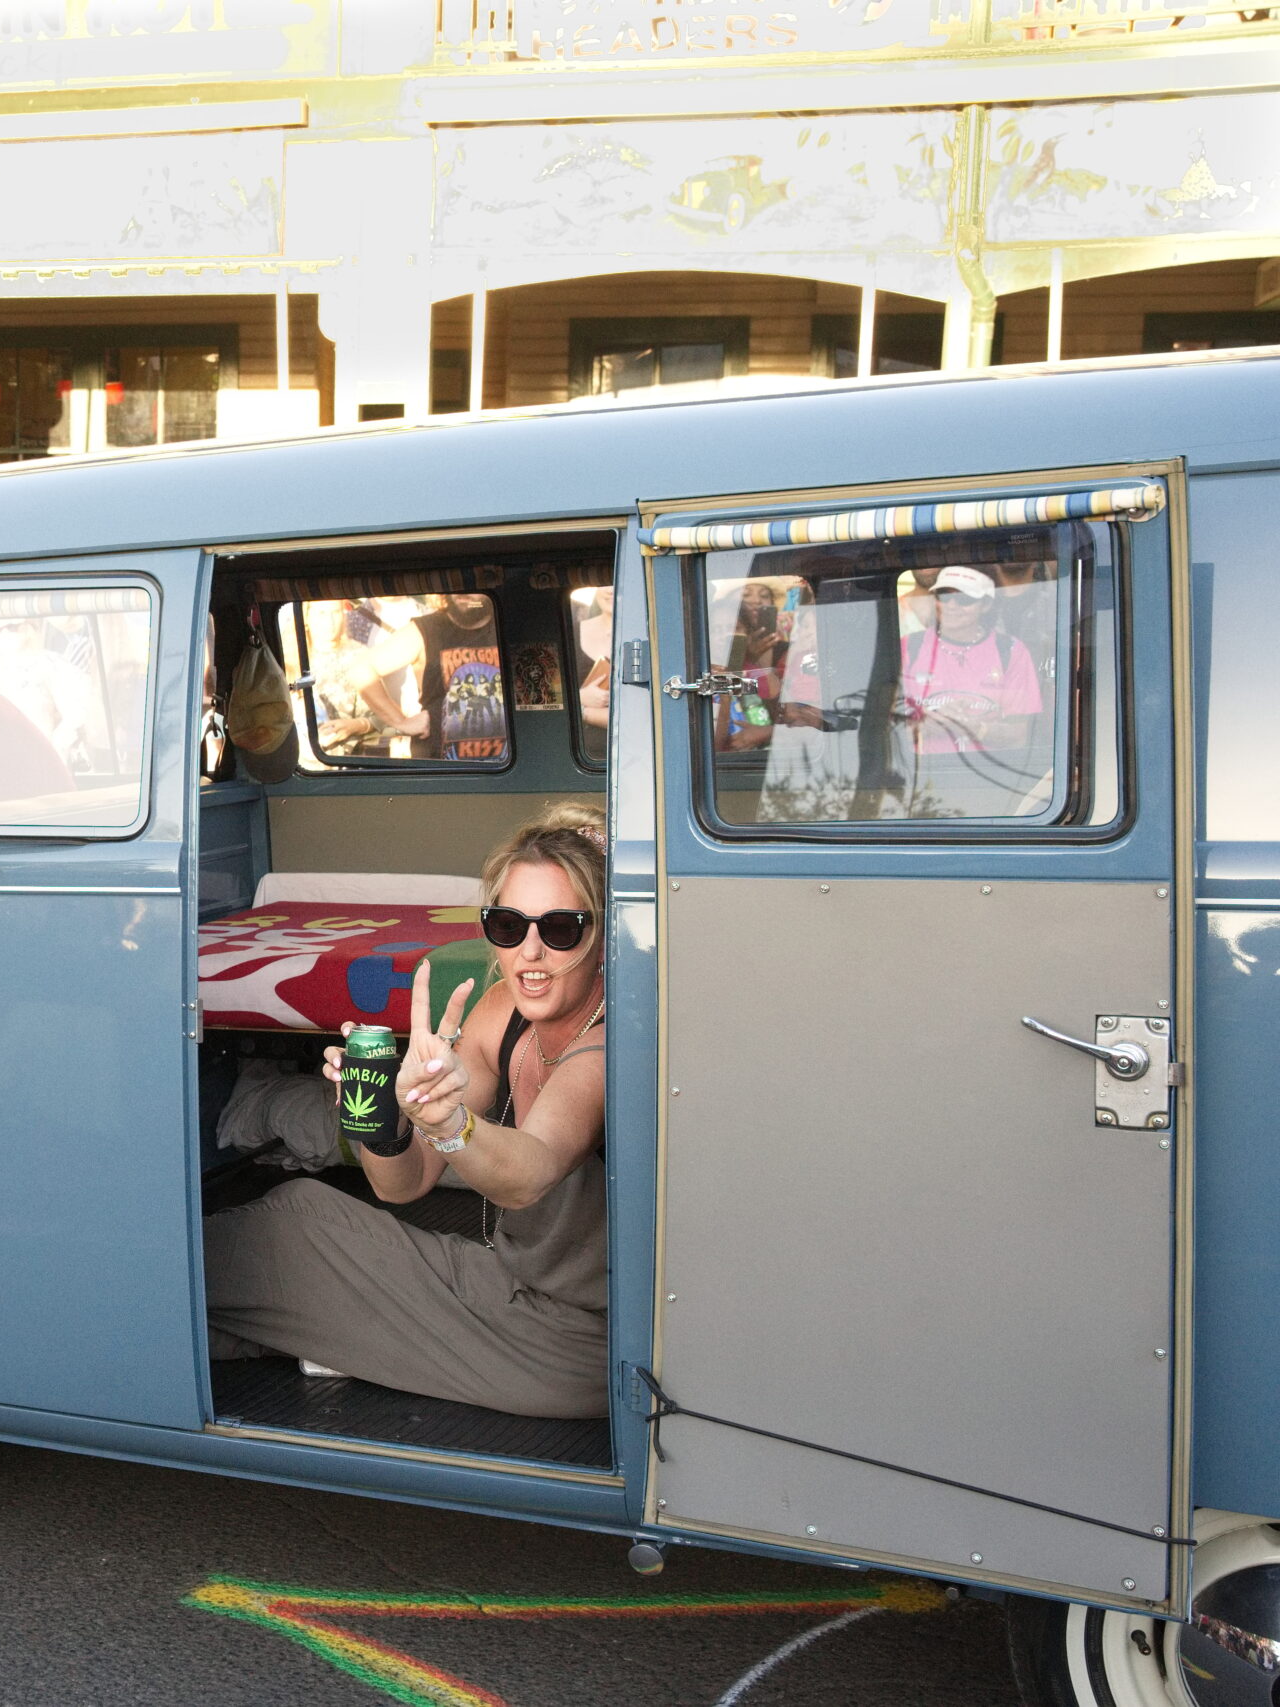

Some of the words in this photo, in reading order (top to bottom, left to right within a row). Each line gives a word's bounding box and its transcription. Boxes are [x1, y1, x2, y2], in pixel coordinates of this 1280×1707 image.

[530, 11, 799, 58] HEADERS
[458, 739, 504, 758] KISS
[340, 1067, 389, 1088] NIMBIN
